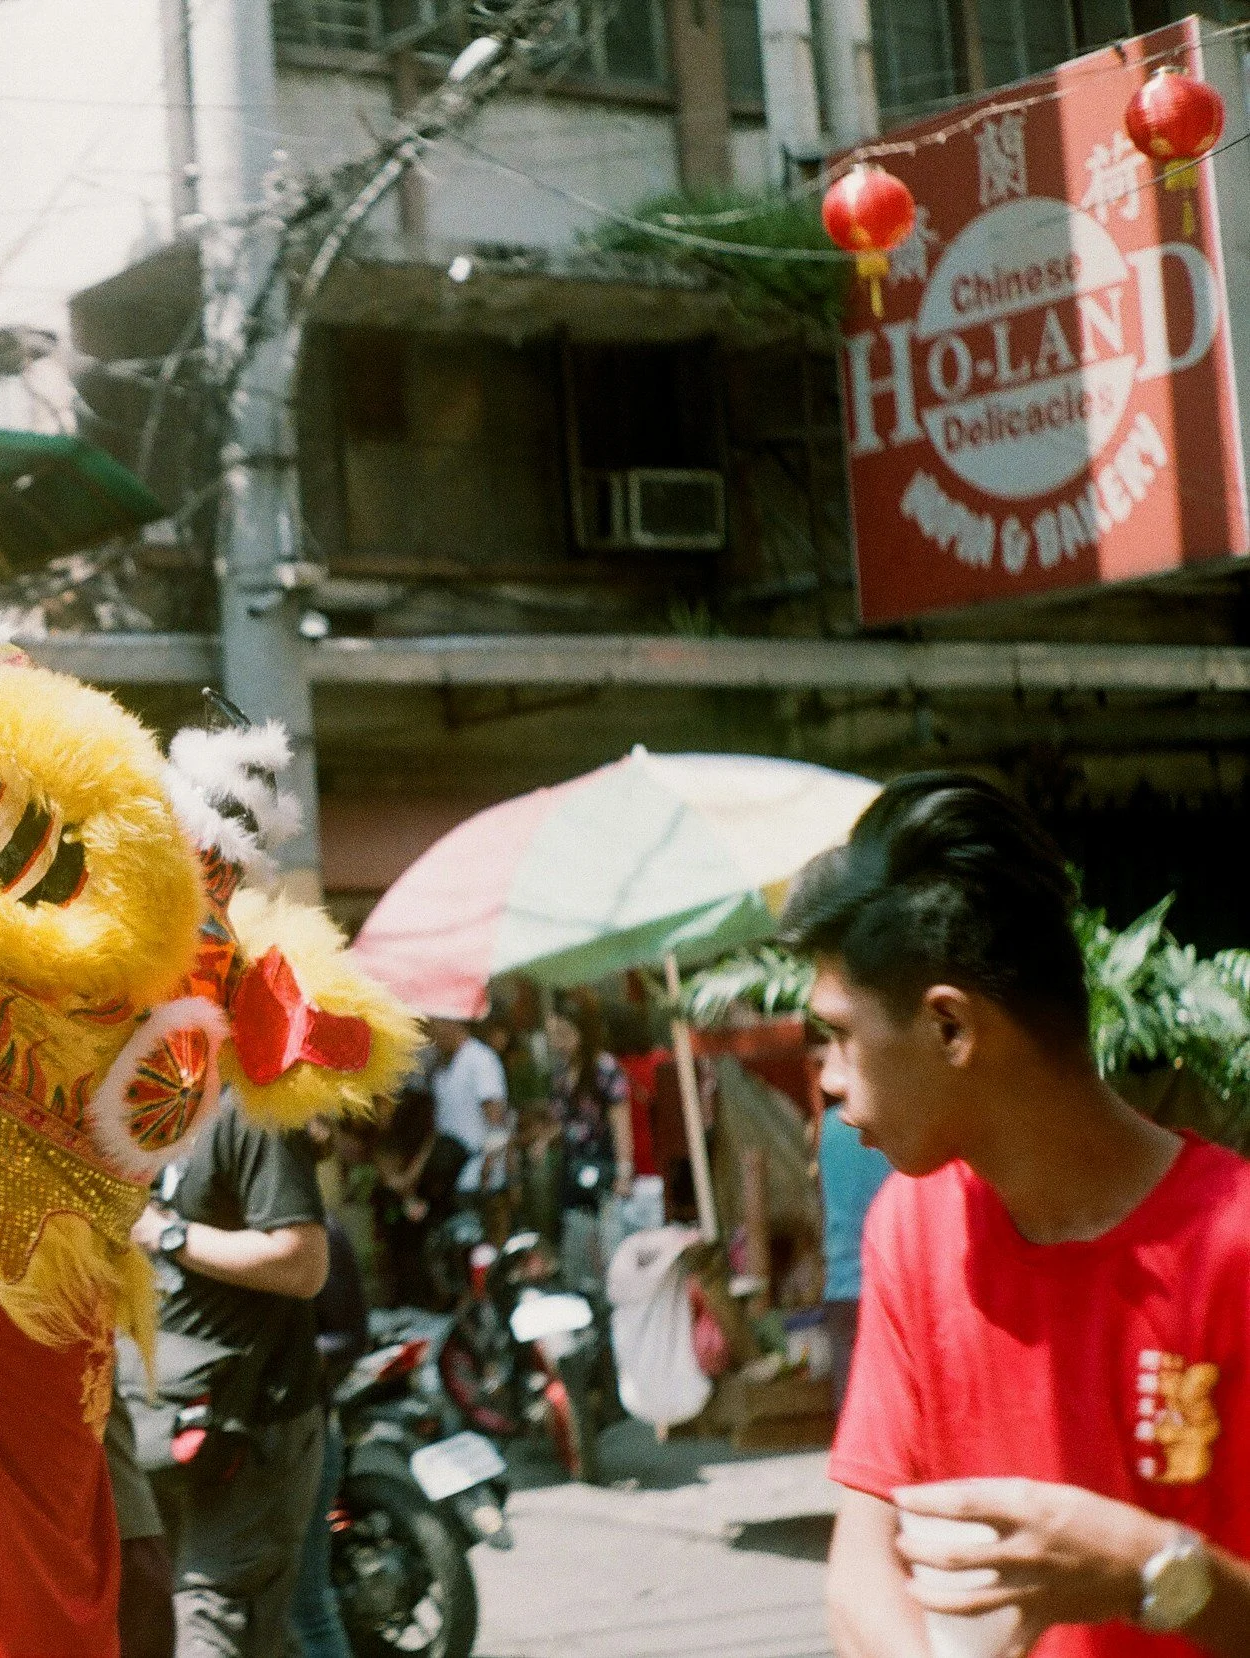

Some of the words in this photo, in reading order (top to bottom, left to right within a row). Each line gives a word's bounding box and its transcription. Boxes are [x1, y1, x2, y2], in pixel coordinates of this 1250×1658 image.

[951, 253, 1084, 314] Chinese
[846, 241, 1220, 457] HO-LAND
[942, 378, 1117, 454] Delicacies
[1032, 410, 1168, 570] BAKERY
